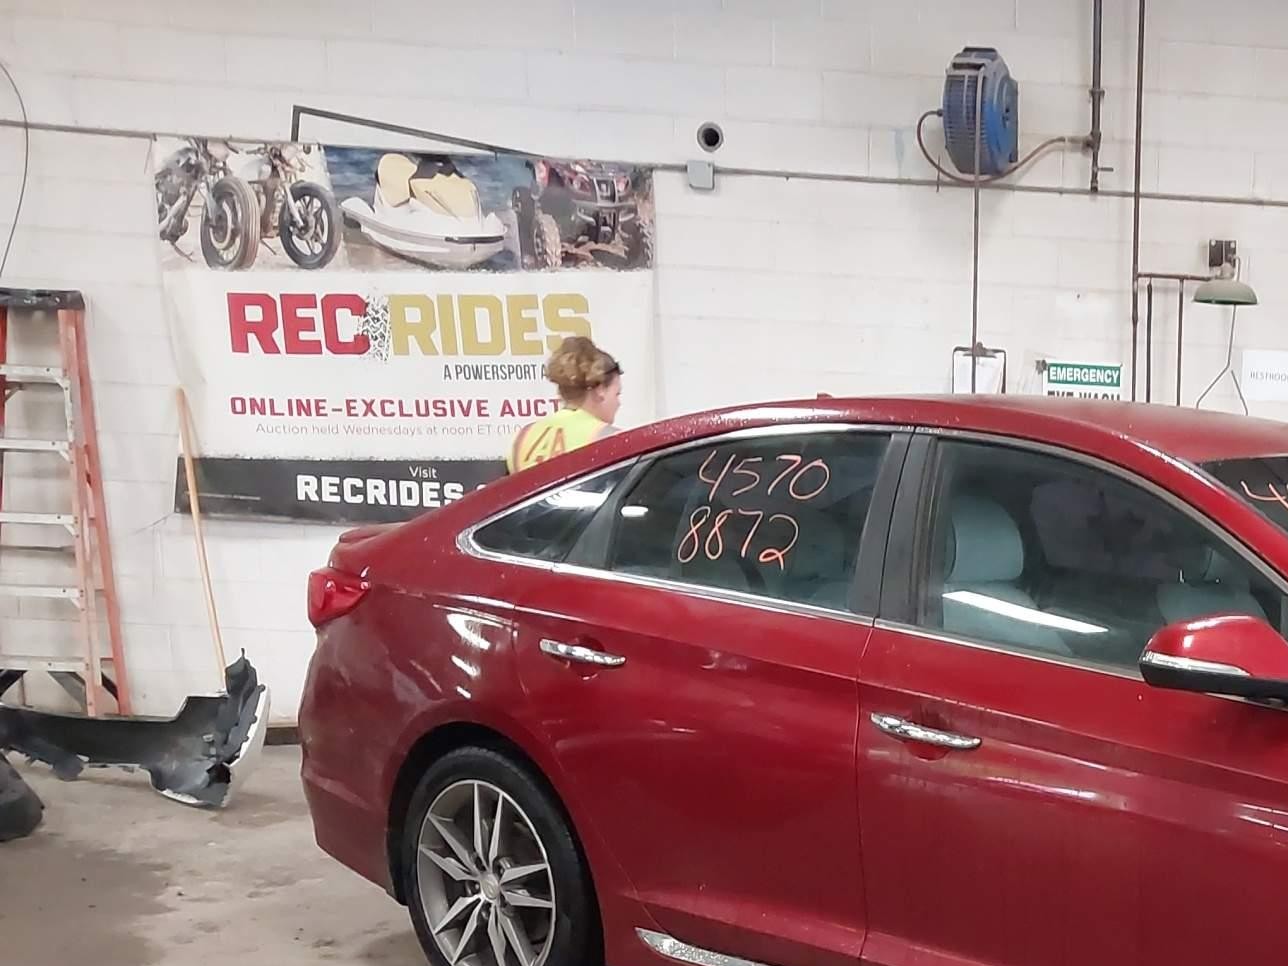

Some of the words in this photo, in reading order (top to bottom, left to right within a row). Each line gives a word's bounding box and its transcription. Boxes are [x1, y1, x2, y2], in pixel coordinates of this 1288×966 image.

[227, 293, 370, 355] REC
[388, 293, 591, 356] RIDES
[443, 364, 452, 380] A
[455, 363, 537, 381] POWERSPORT
[1049, 366, 1119, 384] EMERGENCY
[230, 397, 490, 418] ONLINE-EXCLUSIVE
[255, 423, 308, 435] Auction
[311, 423, 339, 435] held
[342, 423, 422, 437] Wednesdays
[426, 425, 437, 436] at
[441, 426, 473, 437] noon
[477, 424, 492, 436] ET
[408, 466, 438, 480] Visit
[699, 450, 830, 501] 4570
[677, 506, 799, 571] 8872
